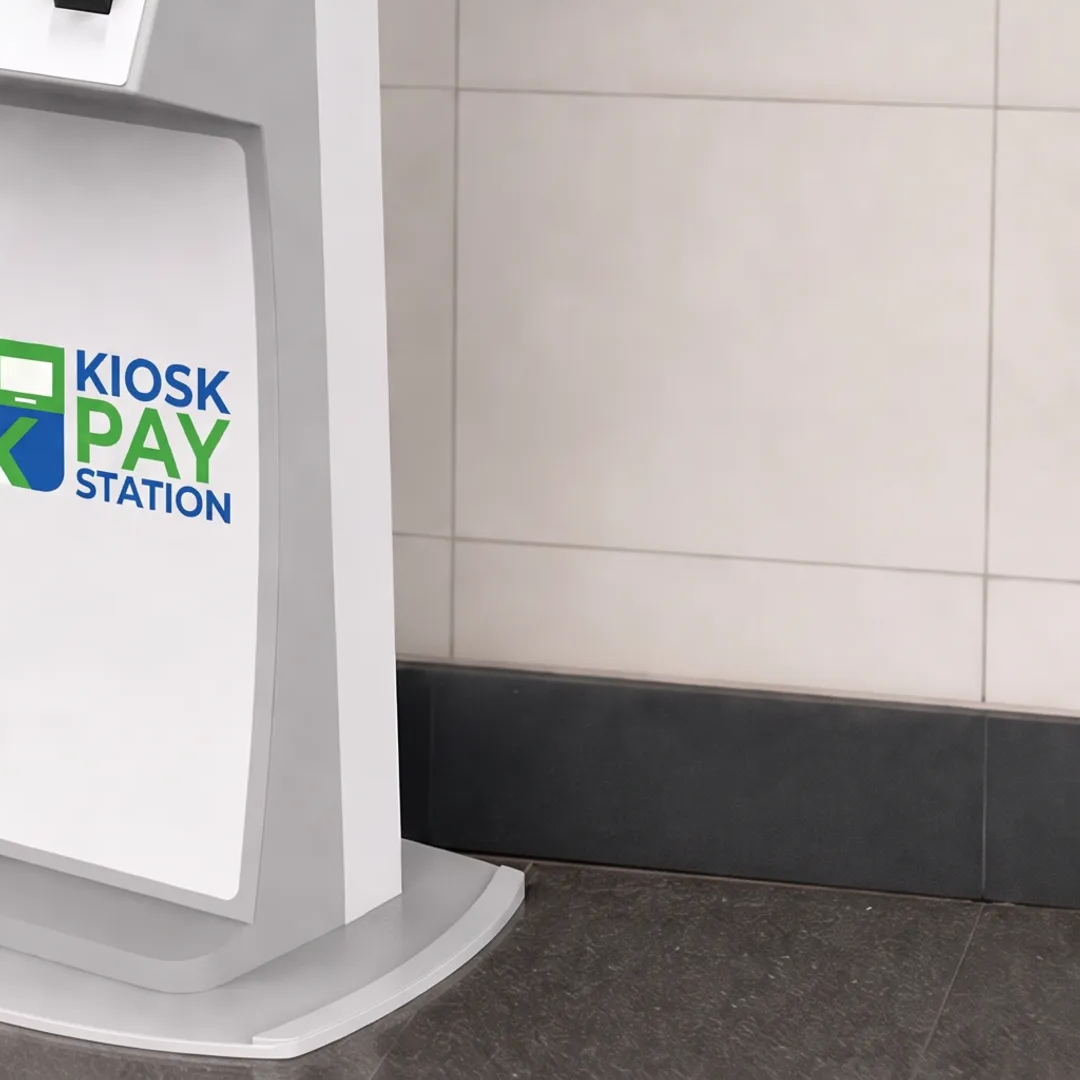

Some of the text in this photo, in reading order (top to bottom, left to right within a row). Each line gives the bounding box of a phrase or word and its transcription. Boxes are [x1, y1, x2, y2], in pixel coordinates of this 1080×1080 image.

[76, 349, 230, 415] KIOSK
[77, 396, 230, 484] PAY
[76, 467, 231, 524] STATION
